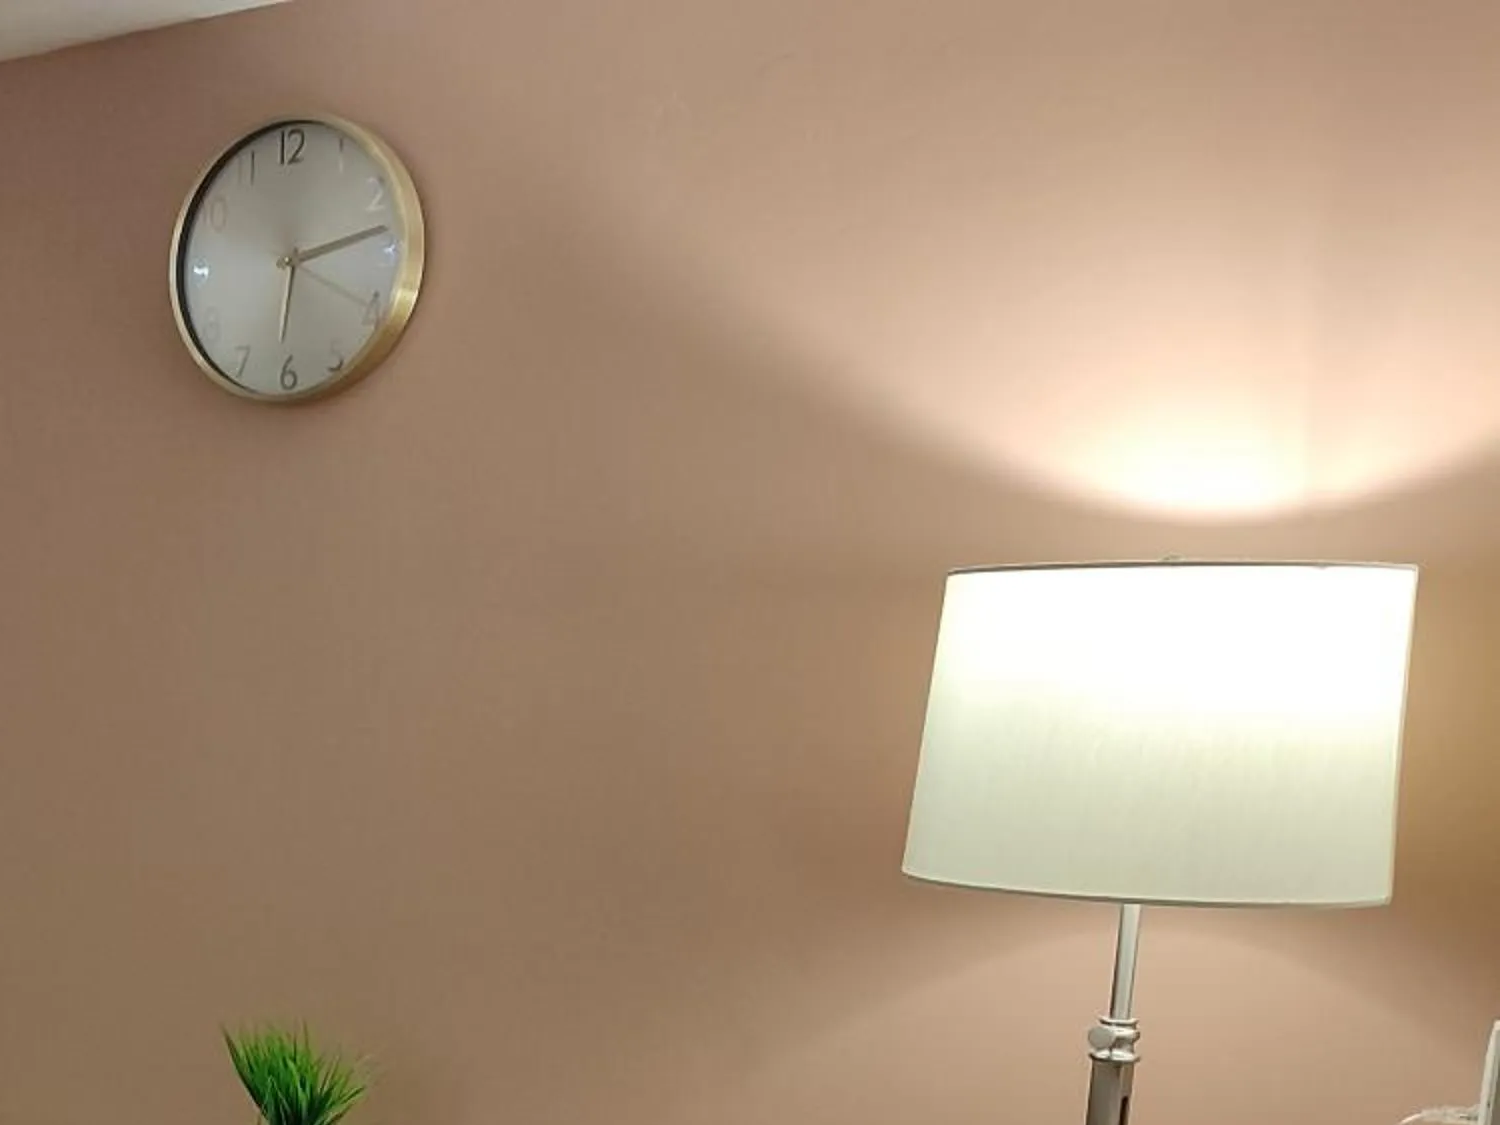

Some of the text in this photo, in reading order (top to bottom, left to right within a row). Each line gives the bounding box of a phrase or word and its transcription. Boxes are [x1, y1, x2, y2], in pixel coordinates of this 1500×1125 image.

[277, 129, 305, 165] 12
[238, 150, 256, 186] 11
[366, 175, 384, 212] 2
[234, 345, 251, 378] 7
[280, 355, 298, 390] 6
[327, 341, 344, 373] 5
